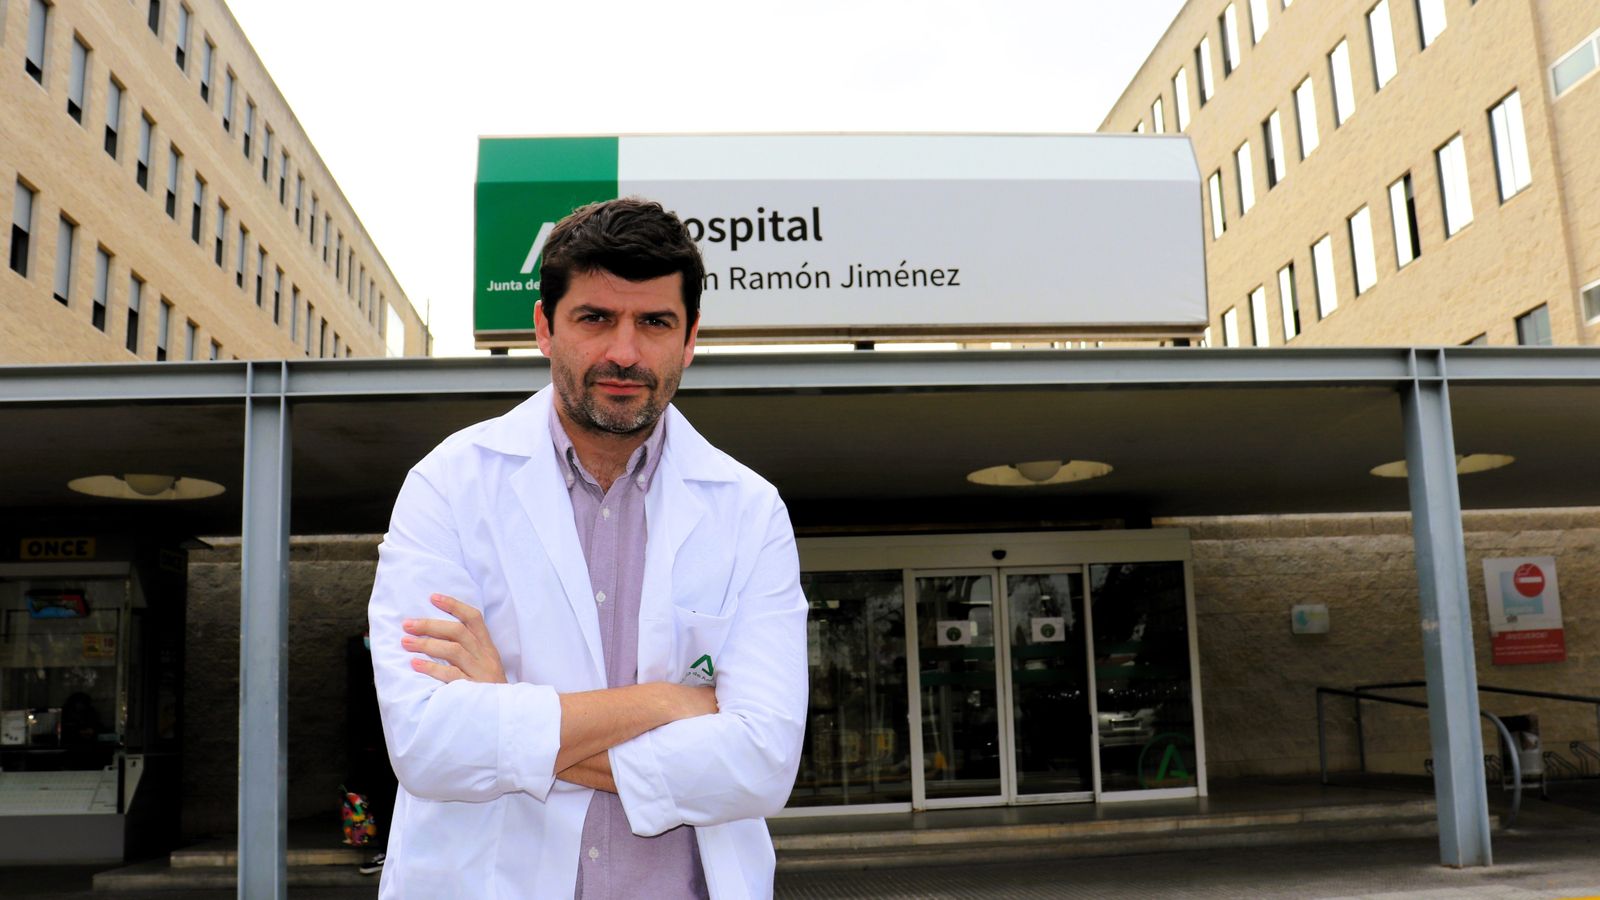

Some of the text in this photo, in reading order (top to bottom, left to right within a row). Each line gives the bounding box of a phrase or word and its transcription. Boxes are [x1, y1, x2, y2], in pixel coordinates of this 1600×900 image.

[684, 206, 824, 252] ospital
[486, 279, 541, 292] Junta de
[730, 262, 831, 290] Ramón
[840, 260, 961, 289] Jiménez
[28, 541, 89, 556] ONCE
